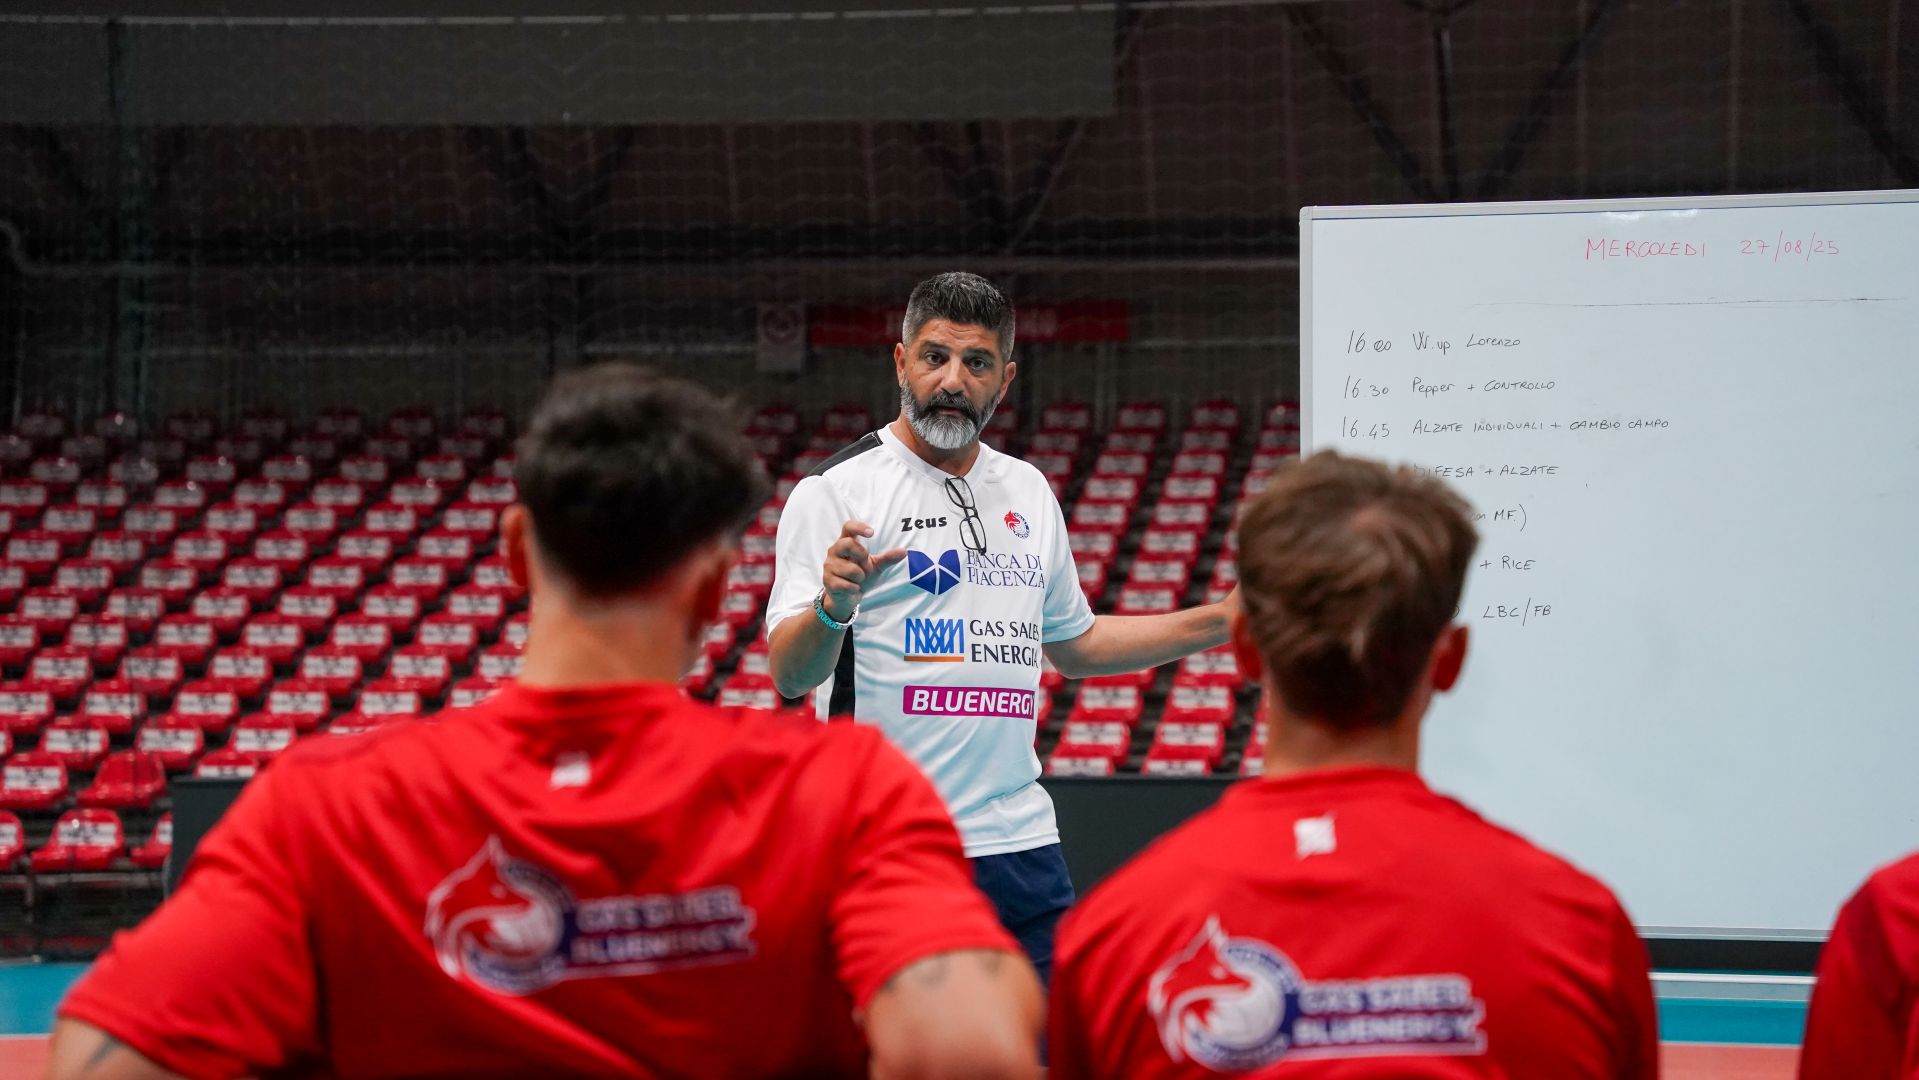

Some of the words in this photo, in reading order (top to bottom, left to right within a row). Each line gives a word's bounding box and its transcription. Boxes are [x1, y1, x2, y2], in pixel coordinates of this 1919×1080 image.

[1585, 238, 1706, 261] MERCOLEDI
[1738, 229, 1841, 263] 27/08/25
[1466, 333, 1521, 348] Lorenzo
[1412, 376, 1456, 398] Pepper
[1467, 383, 1475, 391] +
[1484, 378, 1556, 392] CONTROLLO
[1342, 415, 1390, 439] 16.45
[1412, 418, 1464, 434] ALZATE
[1473, 422, 1544, 433] INDIVIDUALI
[1569, 419, 1621, 431] CAMBIO
[1628, 418, 1670, 430] CAMPO
[1484, 467, 1494, 476] +
[1499, 464, 1559, 477] ALZATE
[901, 516, 948, 532] Zeus
[966, 549, 1020, 570] BANCA
[1025, 553, 1043, 571] DI
[1479, 559, 1493, 570] +
[1501, 555, 1537, 570] RICE
[966, 566, 1046, 590] PIACENZA
[969, 619, 1006, 638] GAS
[1009, 621, 1040, 642] SALES
[971, 643, 1039, 668] ENERGIA
